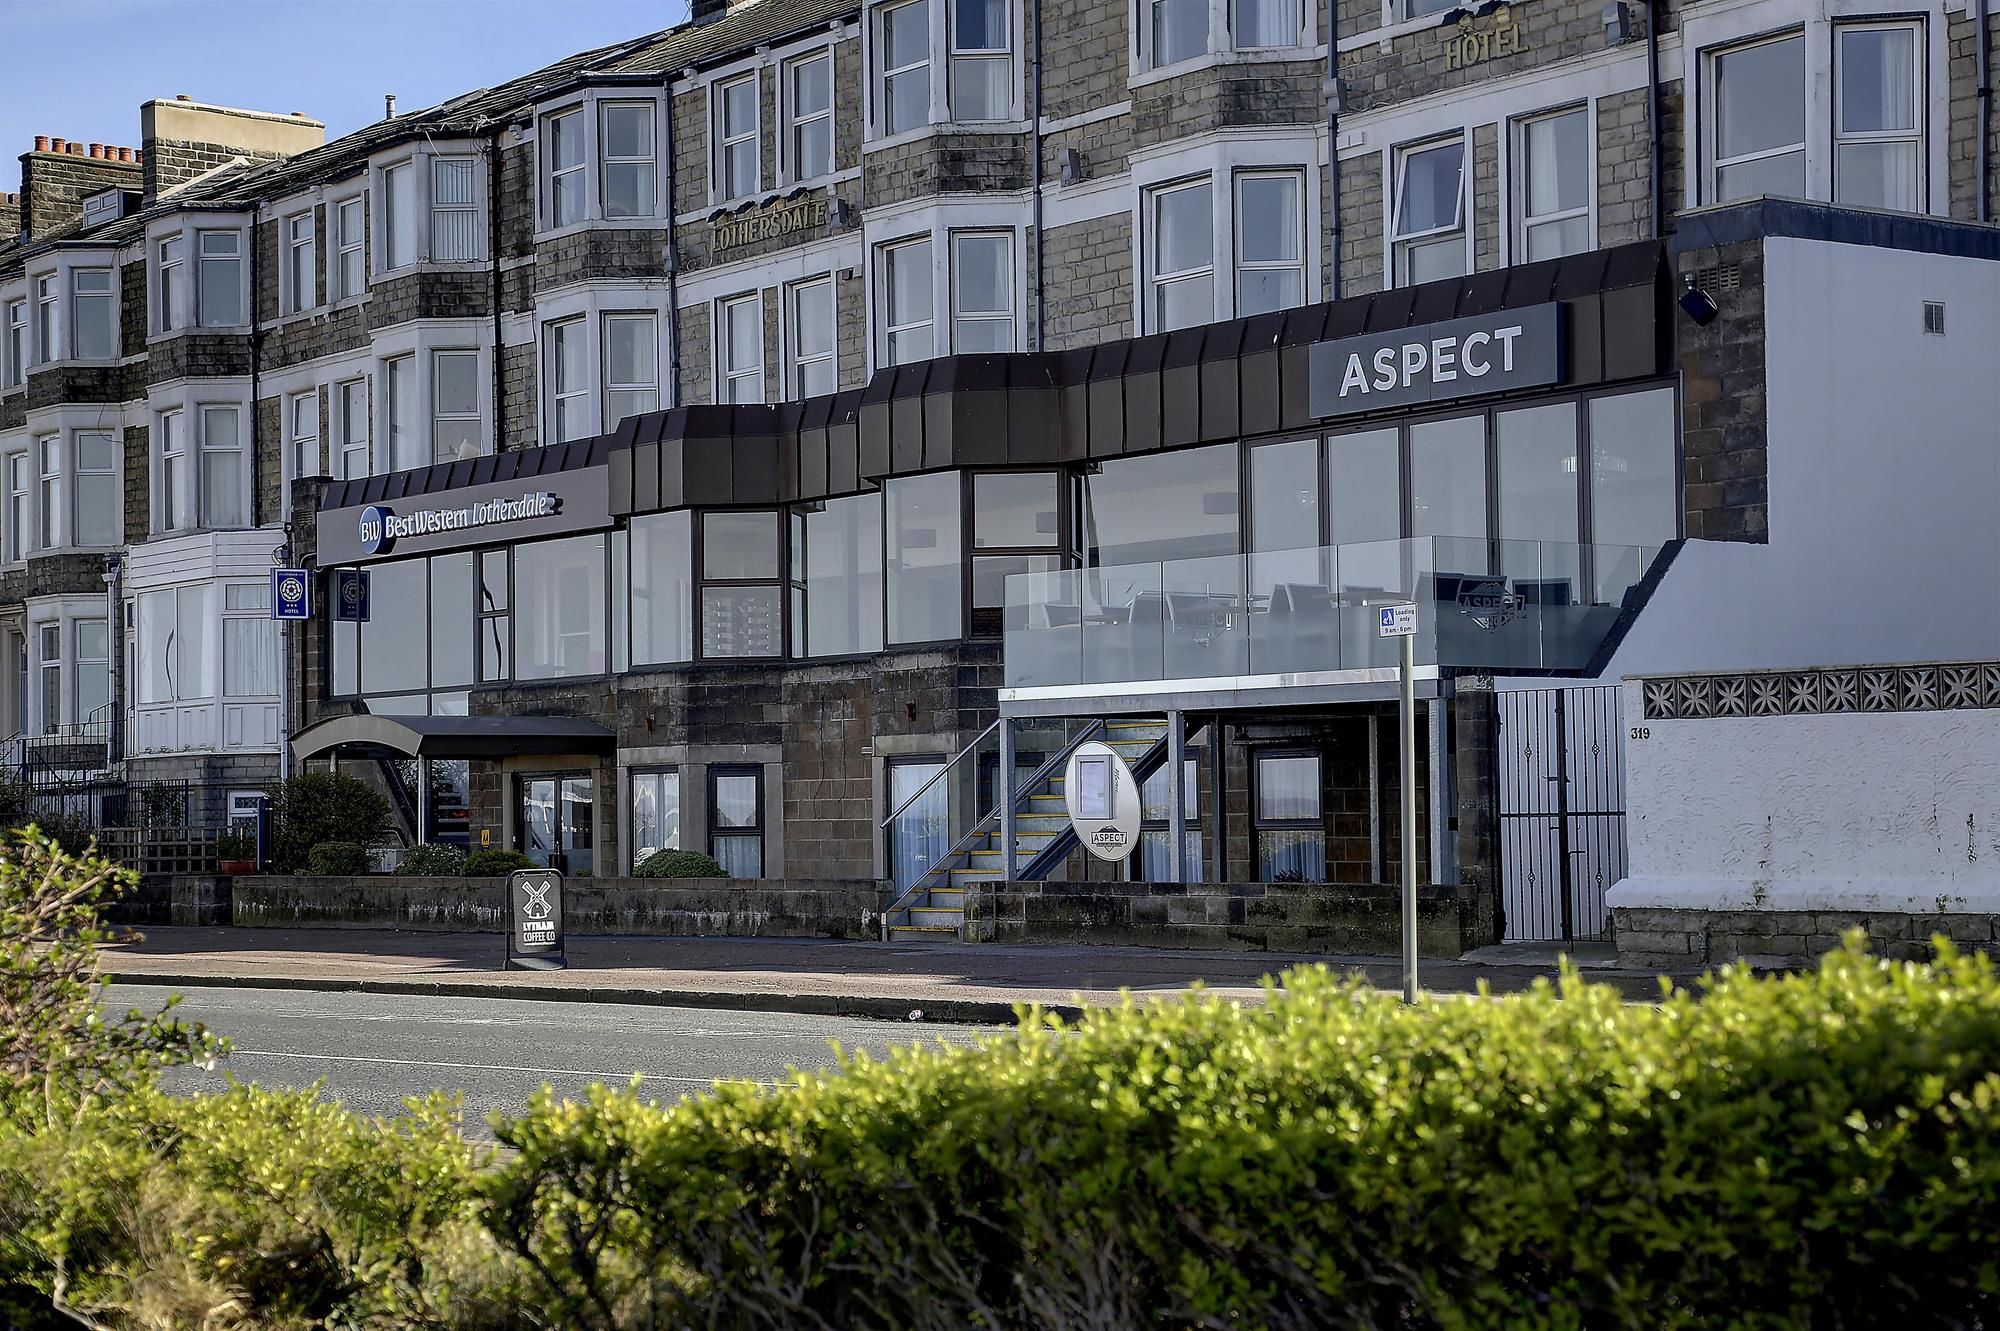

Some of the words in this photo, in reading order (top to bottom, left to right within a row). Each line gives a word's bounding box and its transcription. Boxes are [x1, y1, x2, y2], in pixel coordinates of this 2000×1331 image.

[1444, 23, 1529, 71] HOTEL
[712, 202, 828, 252] LOTHERSDALE
[1337, 325, 1522, 397] ASPECT
[361, 520, 381, 543] BW
[386, 513, 415, 538] Best
[415, 508, 469, 534] Western
[472, 492, 547, 525] Lothersdale
[1631, 727, 1650, 740] 319
[1093, 833, 1125, 842] ASPECT
[523, 931, 546, 942] COFFEE
[547, 930, 556, 941] CO
